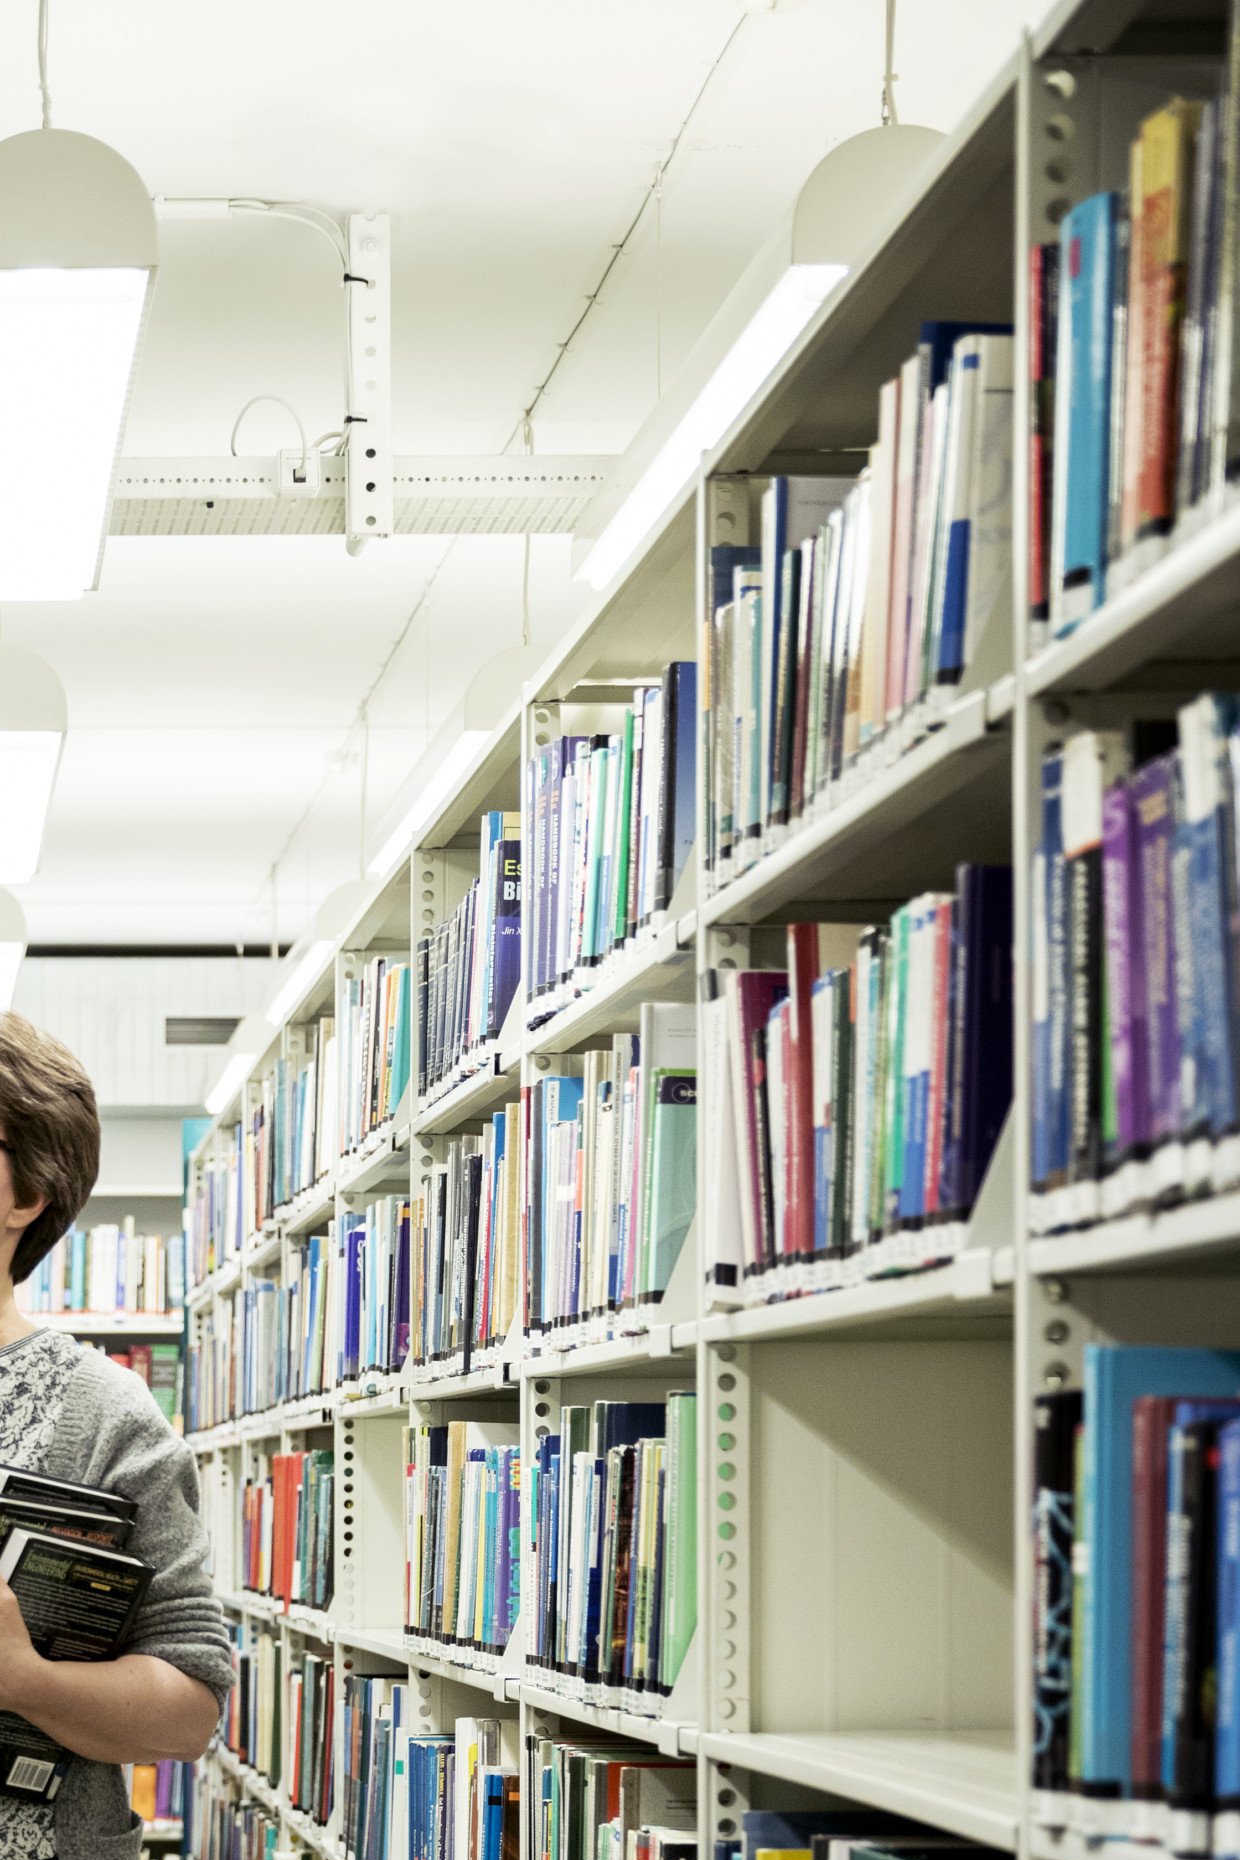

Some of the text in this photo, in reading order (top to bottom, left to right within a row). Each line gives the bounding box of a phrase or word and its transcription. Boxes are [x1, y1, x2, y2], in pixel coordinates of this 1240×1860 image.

[539, 818, 547, 889] HANDBOOK OF
[551, 813, 559, 885] HANDBOOK OF
[501, 926, 515, 935] Jin
[487, 924, 496, 1004] Bioinformatics
[478, 1281, 486, 1331] PROTOCOLS
[428, 1830, 434, 1841] og
